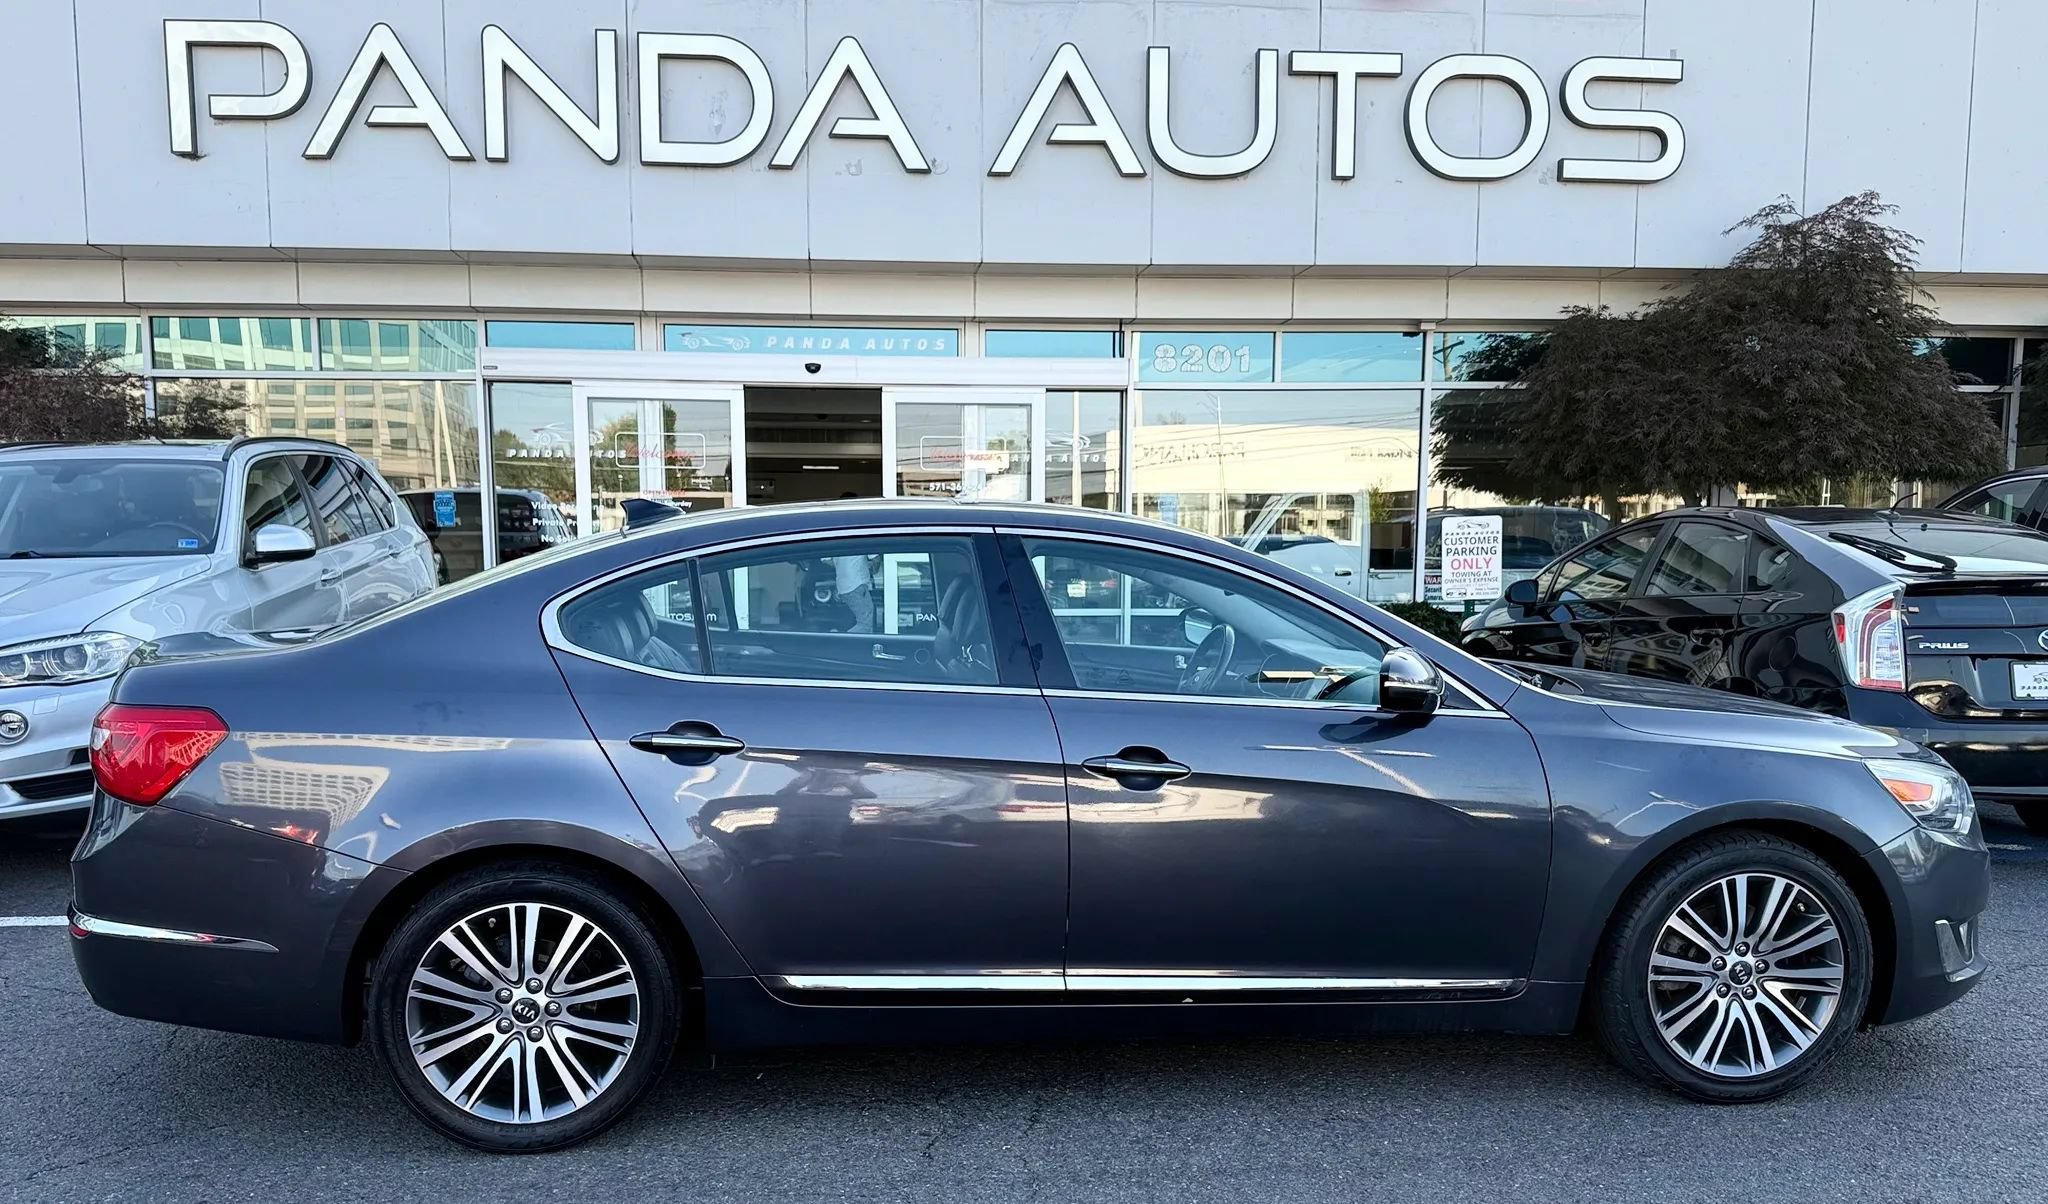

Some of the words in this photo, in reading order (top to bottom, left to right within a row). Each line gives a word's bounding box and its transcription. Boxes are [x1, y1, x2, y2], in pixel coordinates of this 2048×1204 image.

[163, 18, 931, 174] PANDA
[987, 41, 1685, 183] AUTOS
[767, 335, 850, 350] PANDA
[865, 337, 945, 351] AUTOS
[1153, 343, 1250, 373] 8201
[509, 449, 565, 459] PANDA
[541, 534, 554, 543] No
[1444, 536, 1499, 546] CUSTOMER
[1446, 546, 1497, 557] PARKING
[1451, 557, 1492, 571] ONLY
[1734, 964, 1748, 984] KIA
[514, 1002, 536, 1020] KIA
